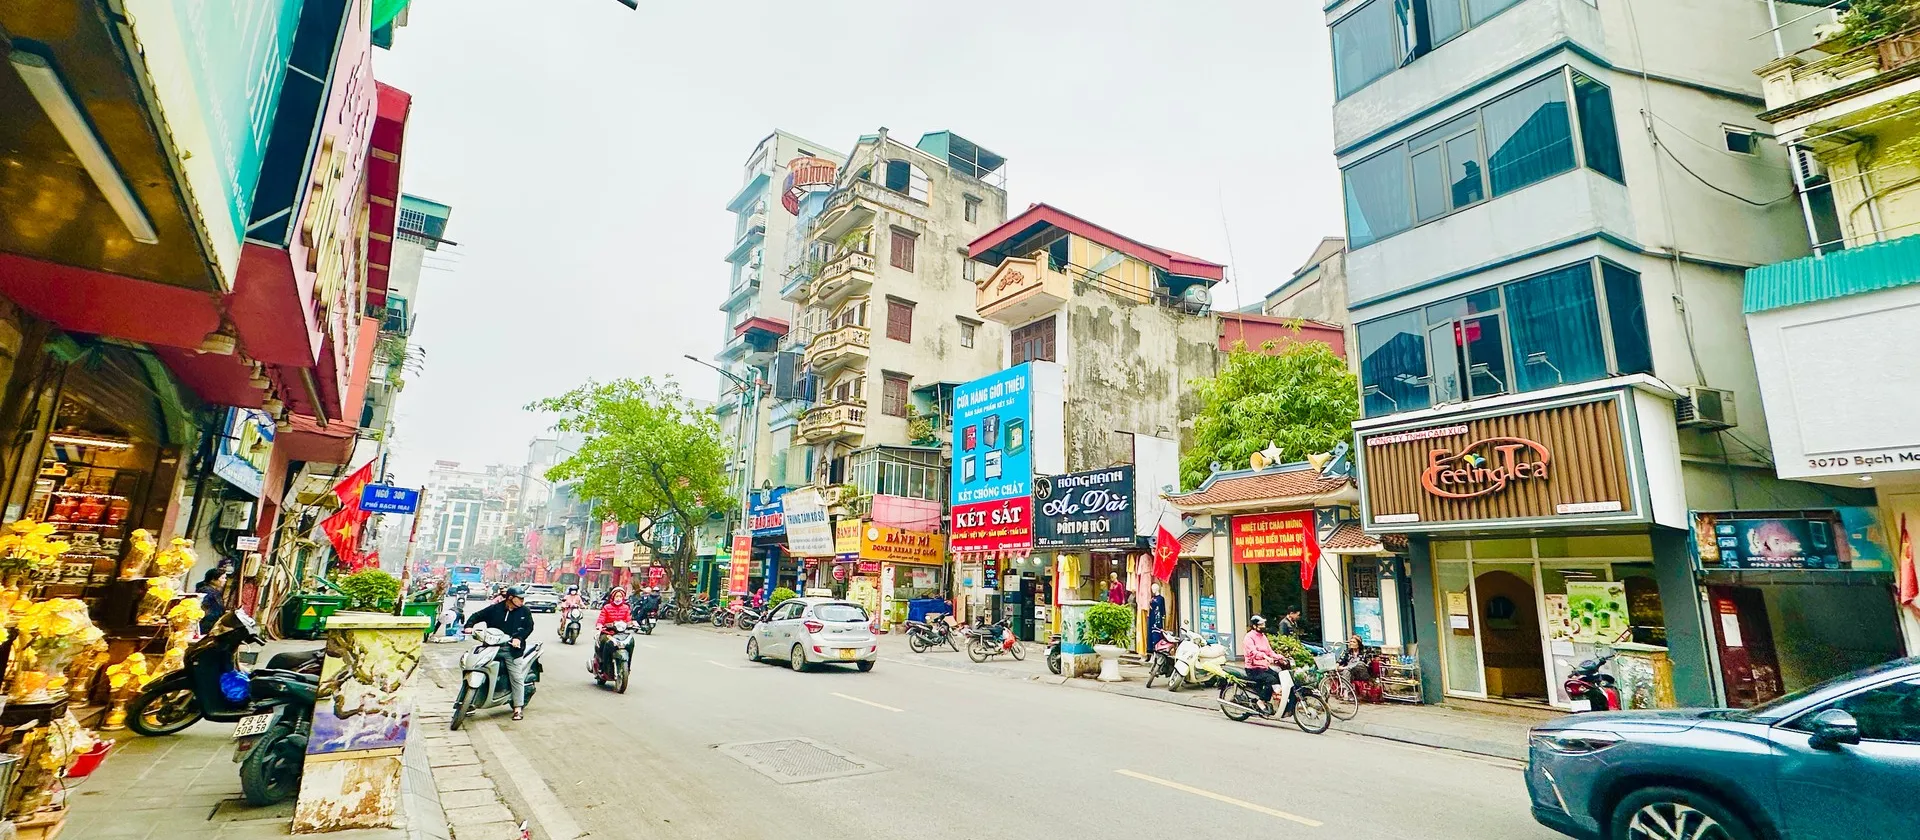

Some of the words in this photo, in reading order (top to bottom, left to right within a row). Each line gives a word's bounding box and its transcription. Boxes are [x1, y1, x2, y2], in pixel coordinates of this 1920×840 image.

[957, 390, 968, 409] CỬA
[970, 388, 988, 405] HÀNG
[1005, 374, 1025, 395] THIỆU
[1808, 457, 1848, 468] 307D
[1854, 453, 1893, 467] Bạch
[1899, 452, 1920, 462] Ma
[393, 490, 405, 499] 300
[958, 488, 973, 501] KÉT
[974, 484, 999, 499] CHỐNG
[1043, 488, 1080, 516] Áo
[1081, 489, 1129, 514] Dài
[956, 508, 986, 528] KÉT
[991, 501, 1022, 525] SẮT
[1257, 521, 1268, 532] LIỆT
[1269, 520, 1284, 530] CHÀO
[886, 531, 915, 545] BÁNH
[1266, 549, 1275, 557] XIV
[1276, 546, 1288, 557] CỦA
[1289, 545, 1302, 556] ĐẢN
